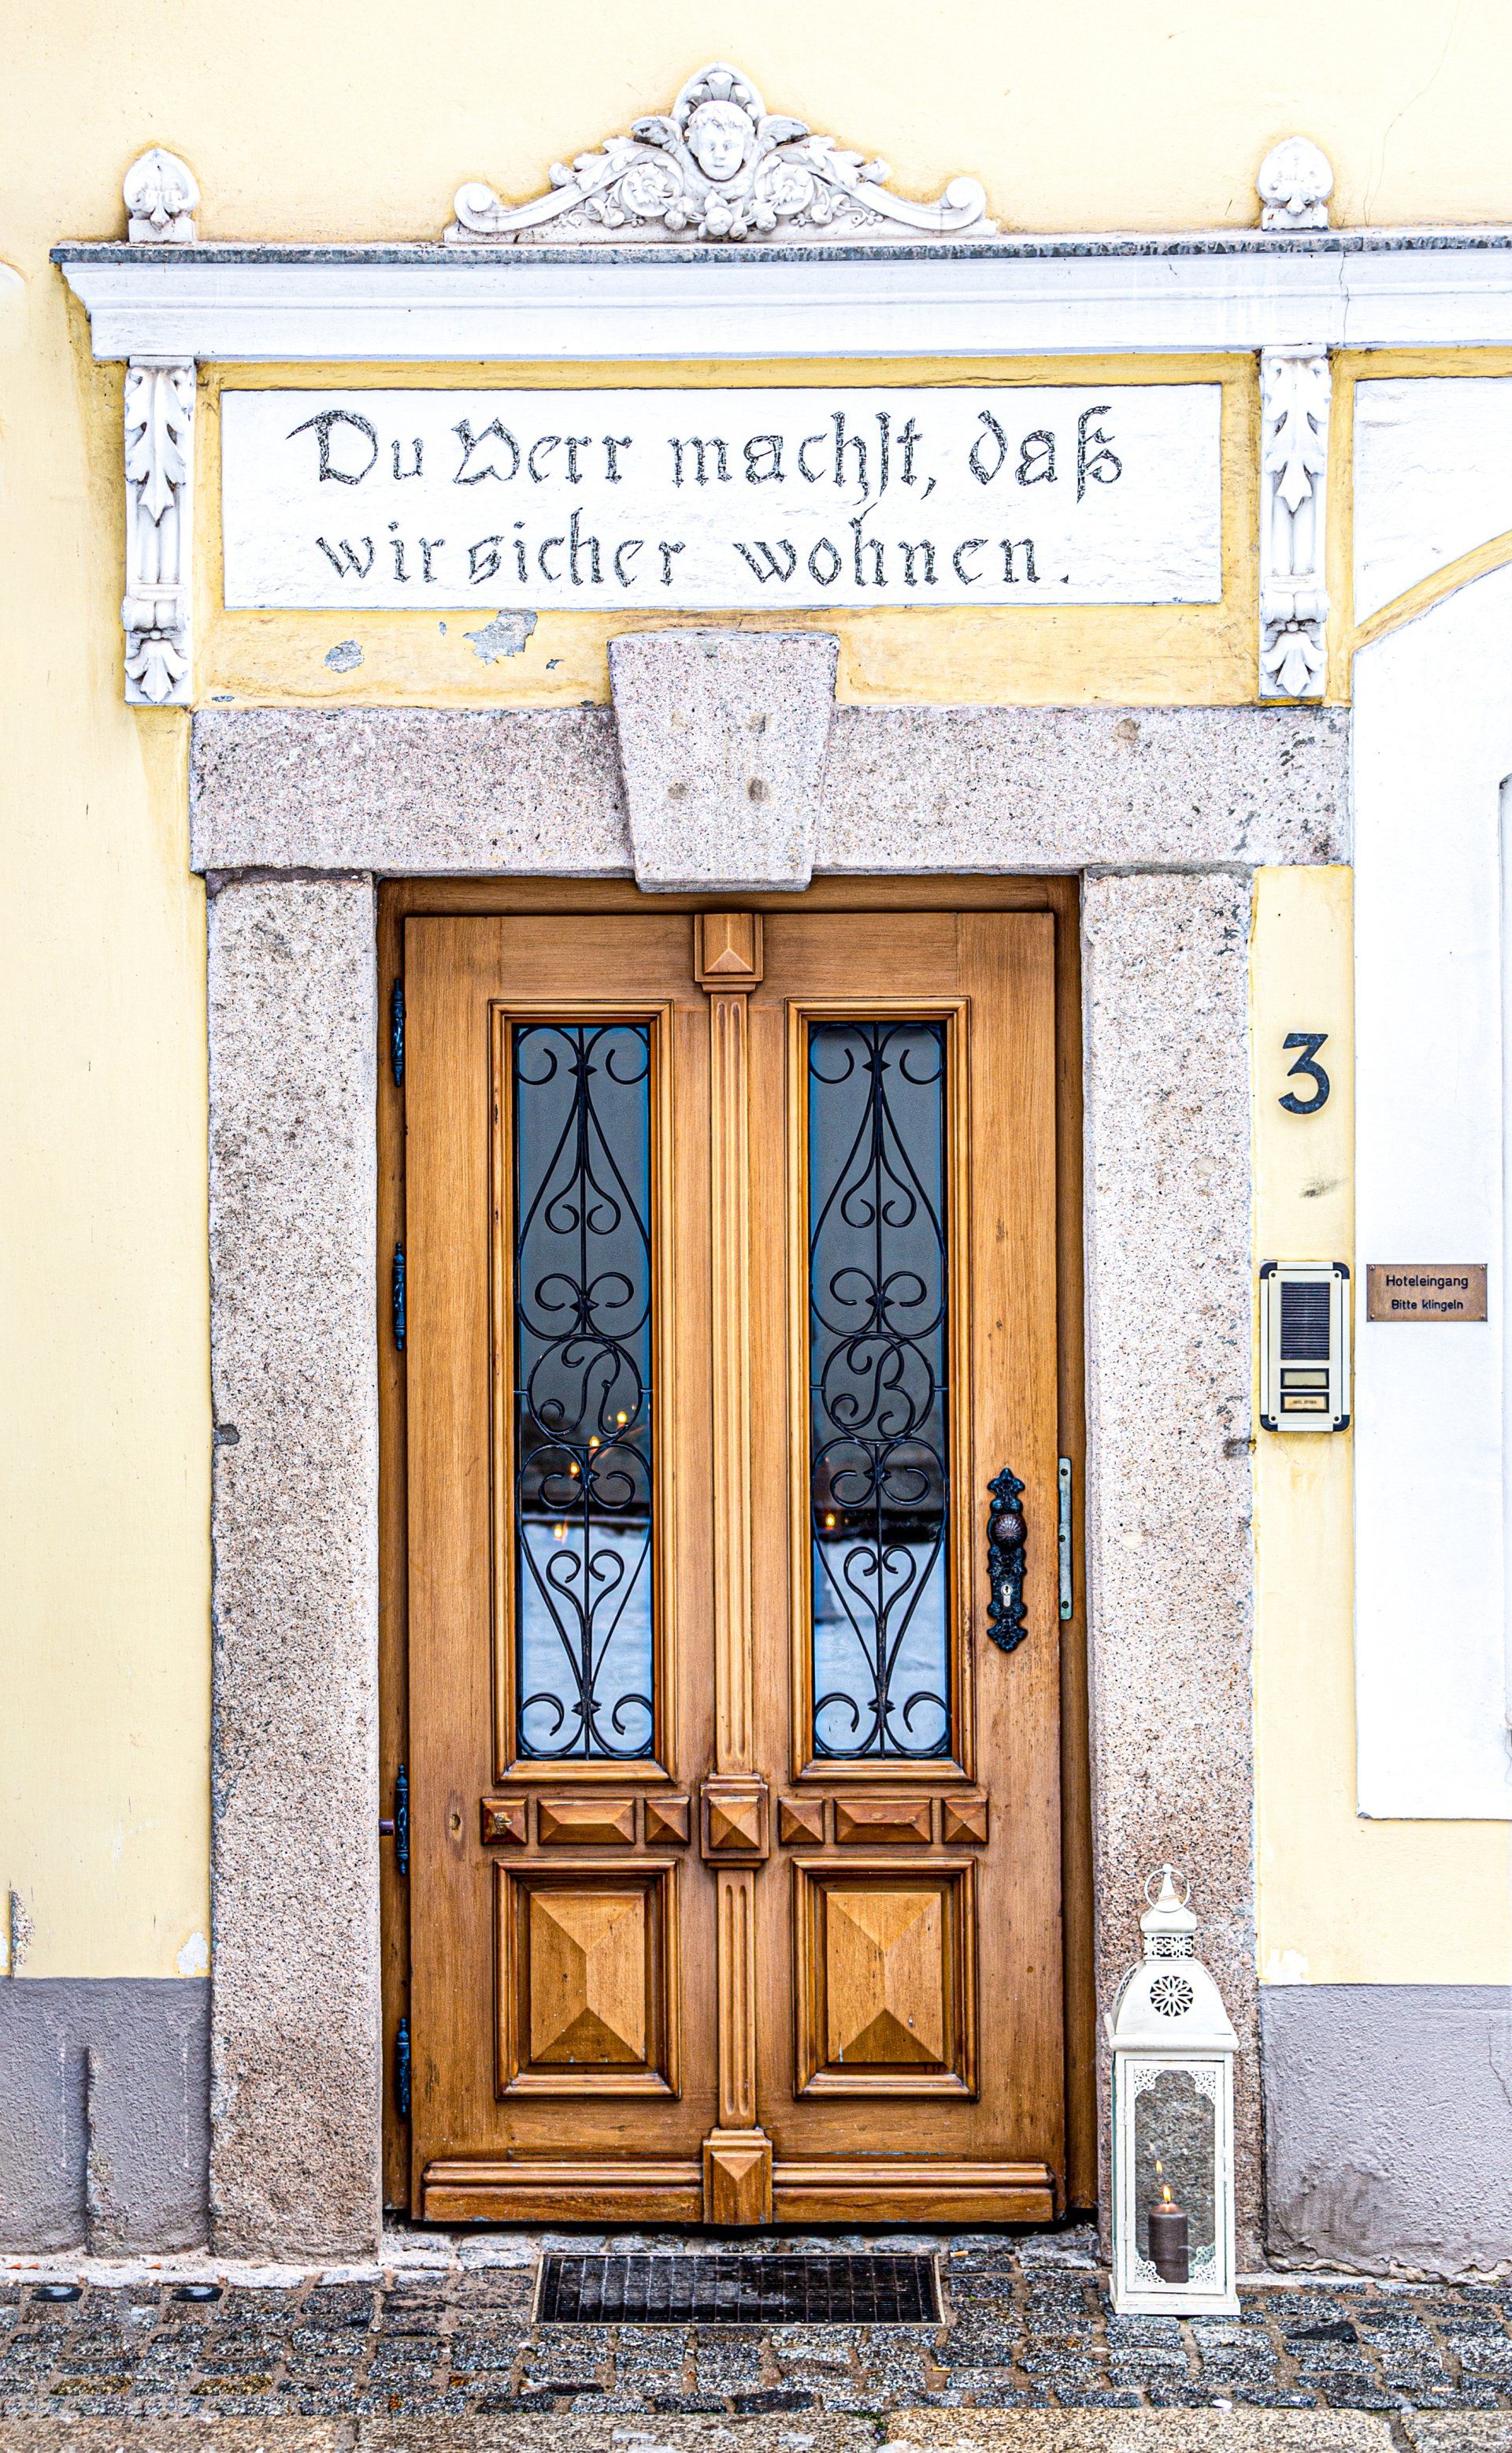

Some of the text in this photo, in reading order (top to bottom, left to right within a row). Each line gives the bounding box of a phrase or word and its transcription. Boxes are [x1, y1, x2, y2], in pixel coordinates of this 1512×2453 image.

[286, 410, 424, 485] Du
[450, 417, 633, 485] Herr
[315, 502, 1069, 588] wir sicher wohnen.
[1278, 1033, 1331, 1115] 3
[1386, 1275, 1469, 1290] Hoteleingang
[1391, 1299, 1464, 1312] Bitte klingeln
